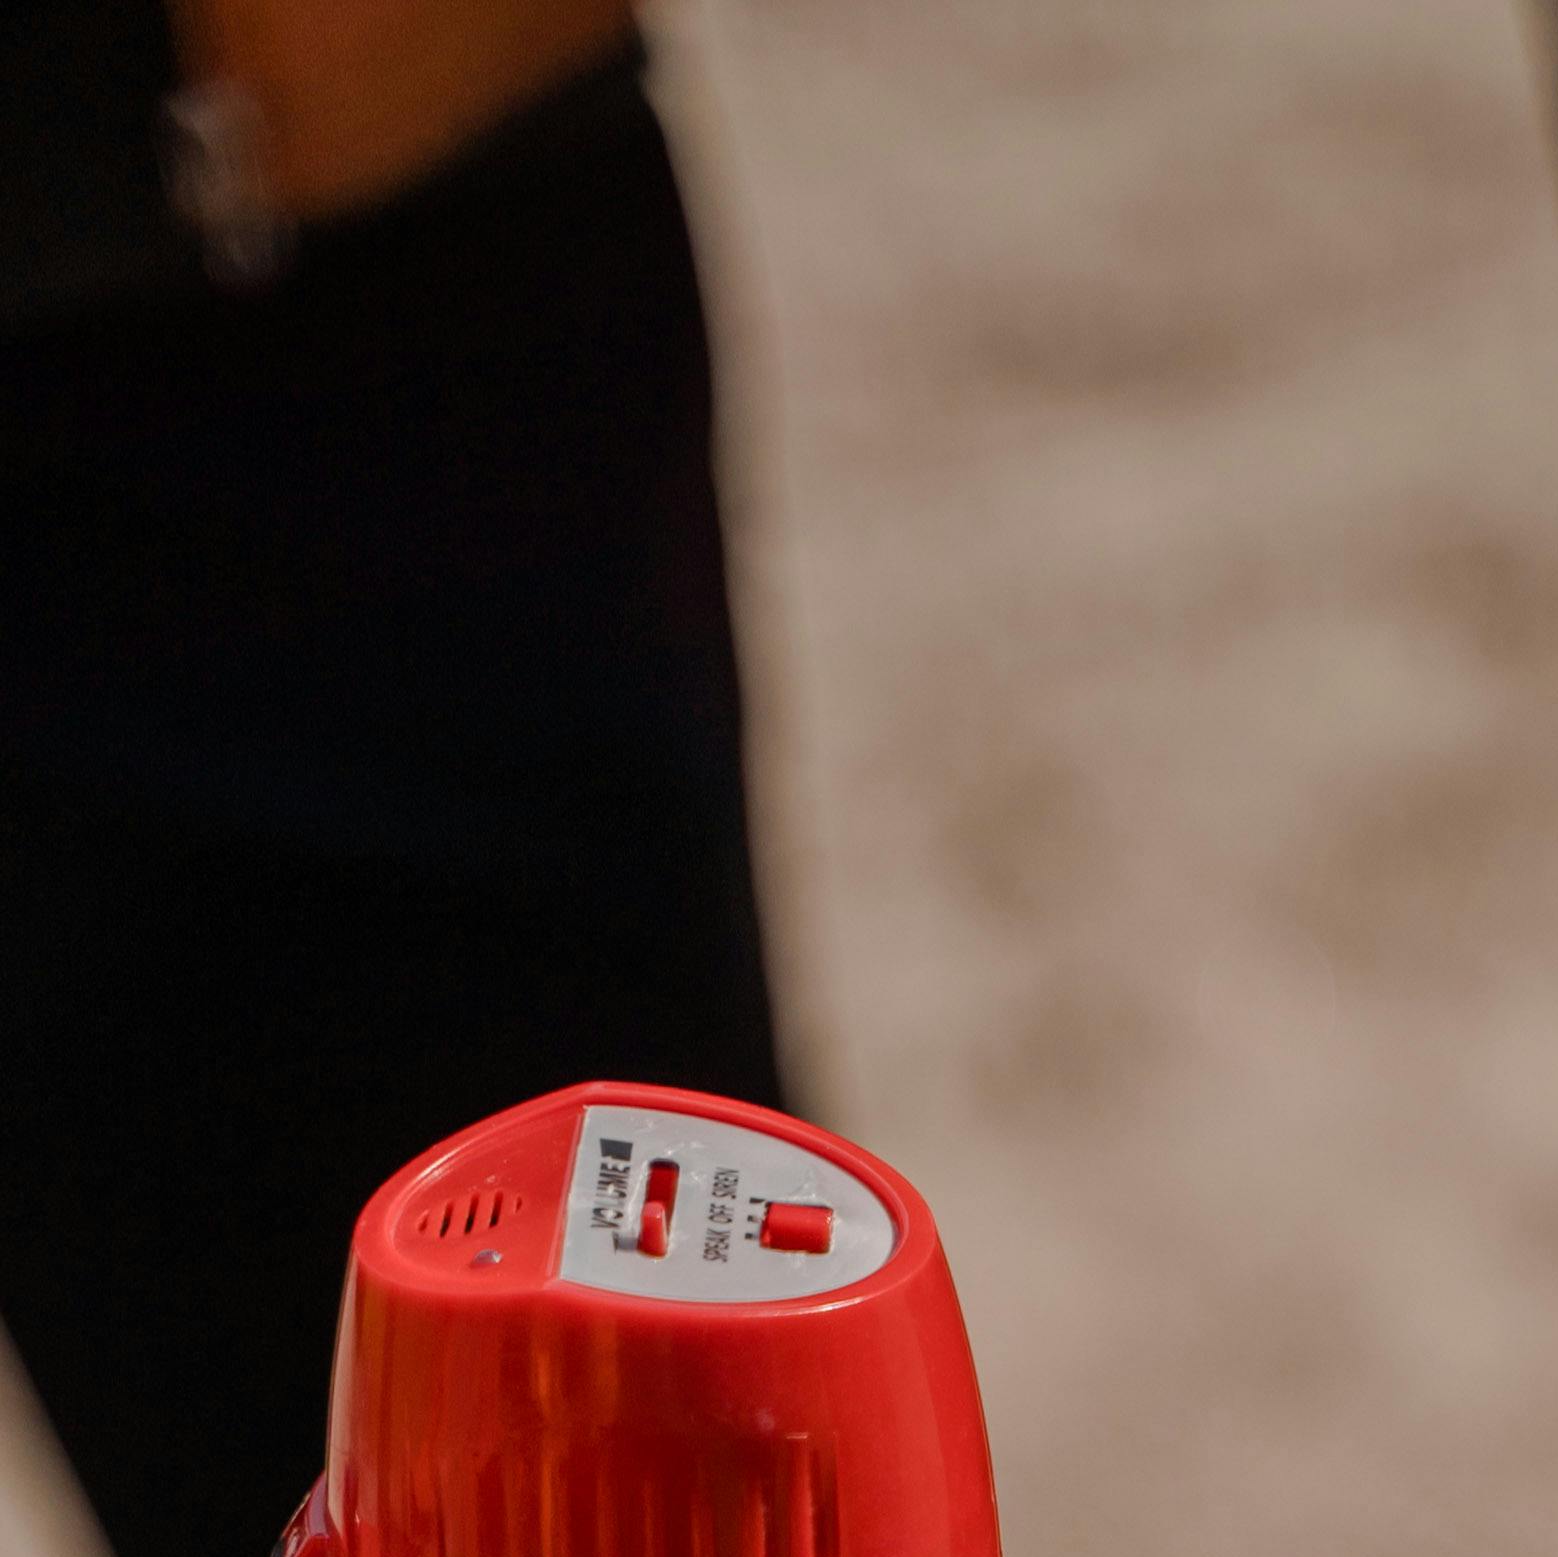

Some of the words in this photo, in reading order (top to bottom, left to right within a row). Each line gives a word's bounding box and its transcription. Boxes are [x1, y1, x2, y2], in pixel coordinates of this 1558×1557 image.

[590, 1162, 631, 1228] VOLUME
[711, 1166, 739, 1199] SIREN
[708, 1203, 735, 1224] OFF
[703, 1228, 731, 1262] SPEAK
